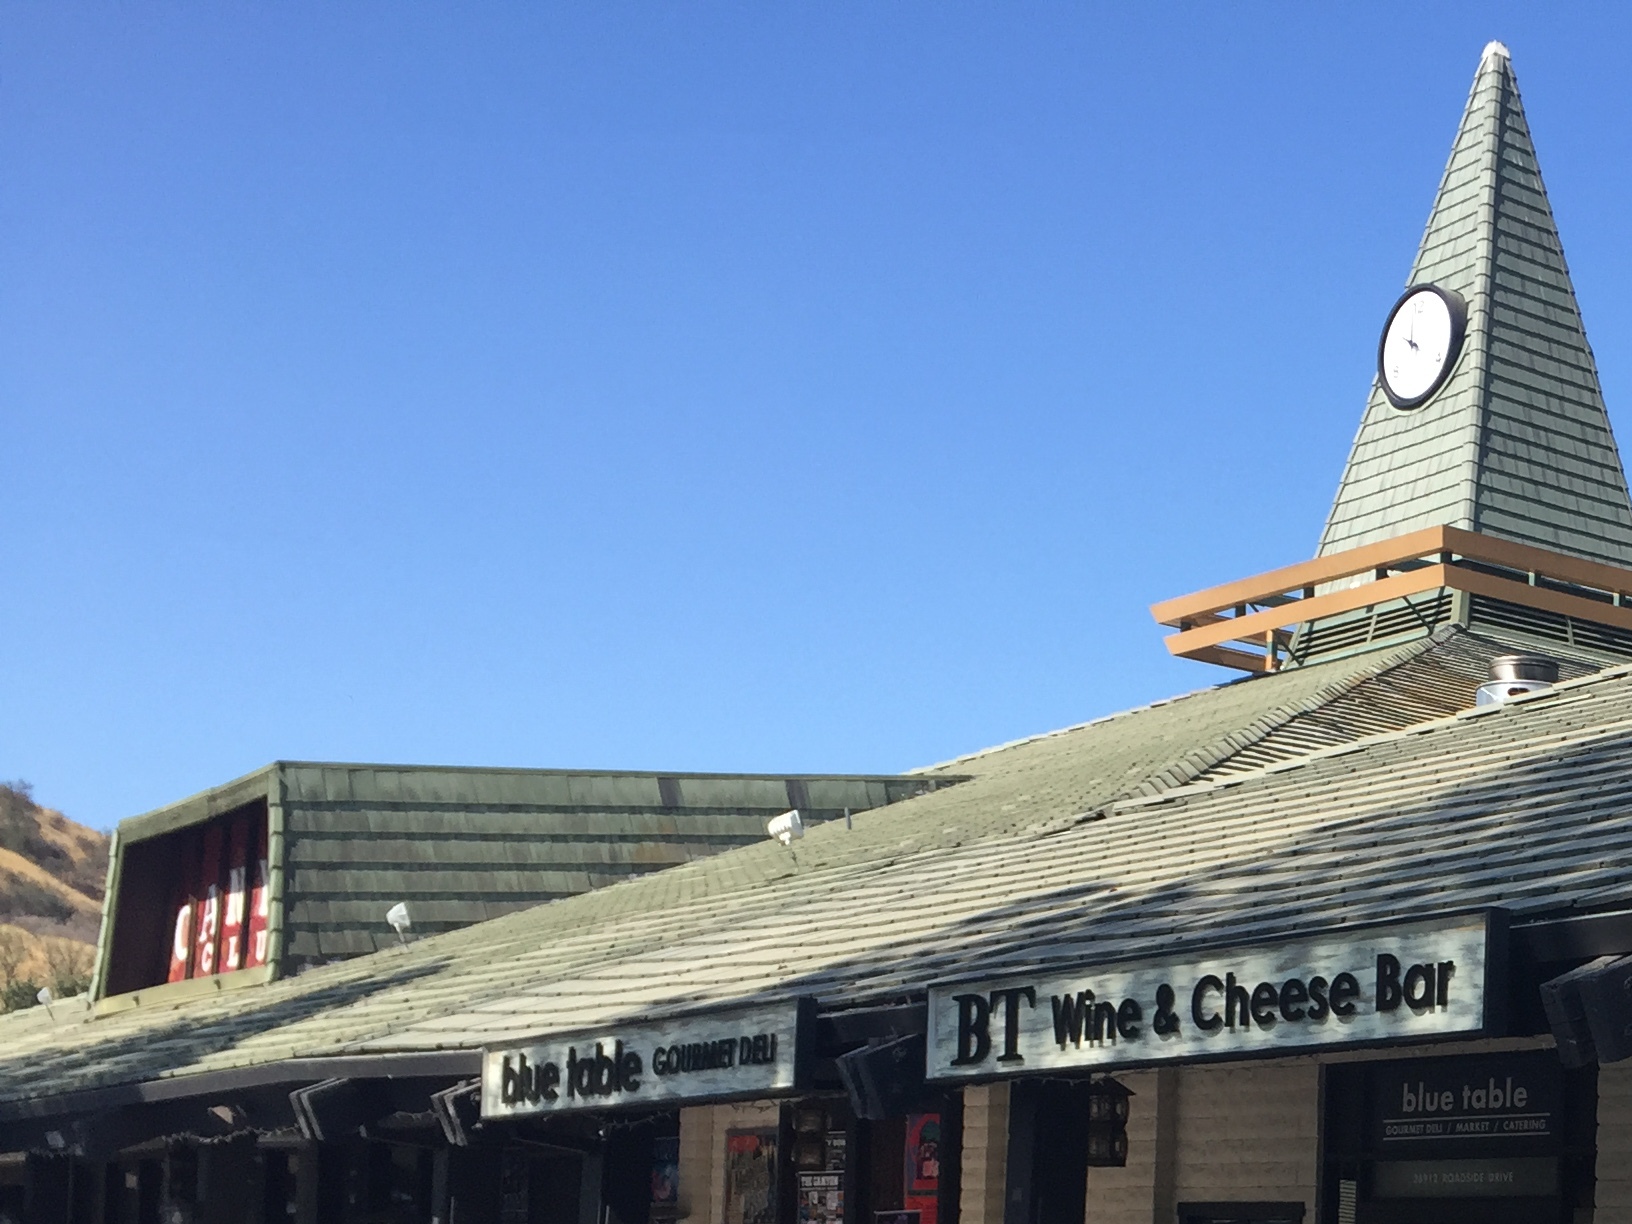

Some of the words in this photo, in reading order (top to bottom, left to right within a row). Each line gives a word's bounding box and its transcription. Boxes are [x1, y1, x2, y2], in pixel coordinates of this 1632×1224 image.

[950, 985, 1037, 1066] BT
[1051, 988, 1143, 1045] Wine
[1153, 982, 1181, 1035] &
[1191, 971, 1360, 1031] Cheese
[1375, 953, 1456, 1012] Bar
[502, 1053, 560, 1104] blue
[567, 1040, 643, 1097] table
[653, 1039, 738, 1076] GOURMET
[739, 1034, 778, 1065] DELI
[1403, 1081, 1454, 1112] blue
[1462, 1077, 1528, 1110] table
[1385, 1124, 1425, 1136] GOURMET
[1426, 1123, 1443, 1134] DELI
[1455, 1121, 1490, 1133] MARKET
[1502, 1119, 1547, 1132] CATERING
[1442, 1172, 1485, 1183] ROADSIDE
[1488, 1171, 1514, 1183] DRIVE
